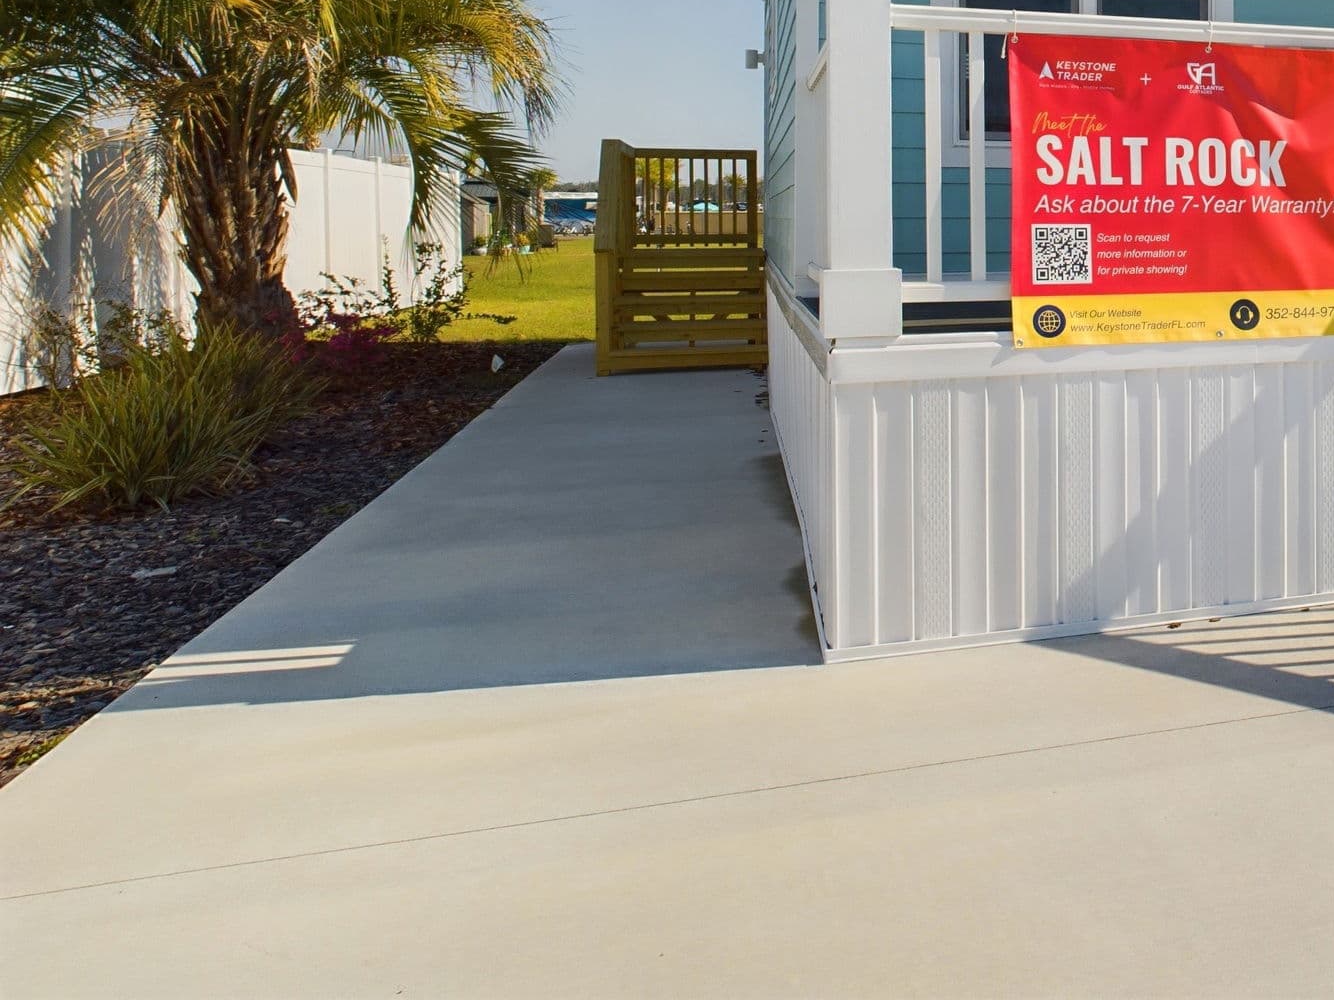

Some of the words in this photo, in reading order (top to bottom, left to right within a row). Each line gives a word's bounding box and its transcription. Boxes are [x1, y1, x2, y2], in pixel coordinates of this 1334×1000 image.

[1056, 61, 1116, 72] KEYSTONE
[1057, 71, 1103, 82] TRADER
[1032, 112, 1078, 138] Meet
[1036, 134, 1149, 186] SALT
[1165, 137, 1288, 187] ROCK
[1034, 194, 1076, 214] Ask
[1079, 194, 1140, 214] about
[1143, 194, 1176, 214] the
[1181, 195, 1247, 214] 7-Year
[1097, 232, 1121, 243] Scan
[1123, 233, 1133, 242] to
[1134, 232, 1170, 244] request
[1096, 250, 1121, 259] more
[1123, 248, 1175, 259] information
[1177, 249, 1187, 258] or
[1097, 265, 1110, 275] for
[1111, 265, 1145, 276] private
[1146, 264, 1188, 276] showing!
[1069, 310, 1088, 319] Visit
[1089, 309, 1106, 319] Our
[1107, 309, 1142, 318] Website
[1070, 319, 1206, 333] www.KeystoneTraderFL.com
